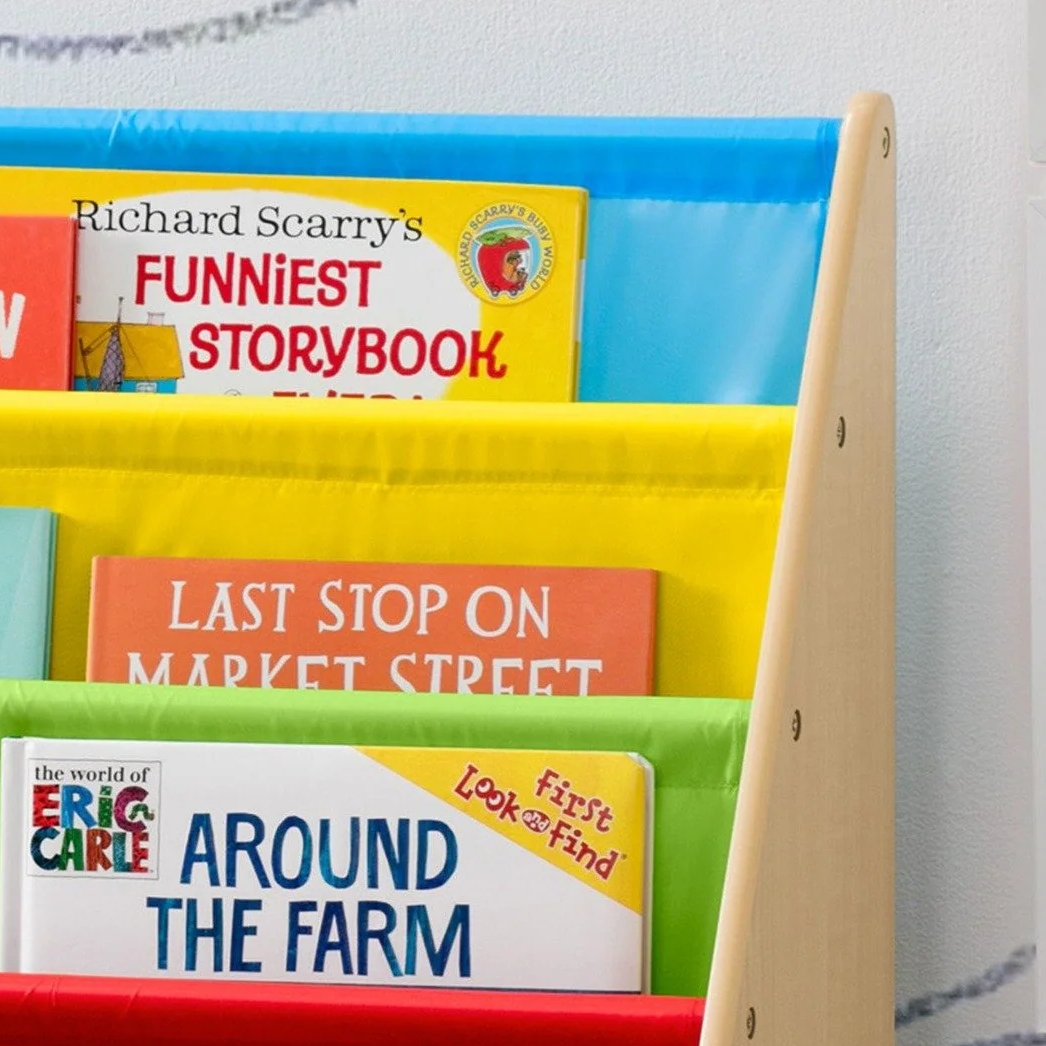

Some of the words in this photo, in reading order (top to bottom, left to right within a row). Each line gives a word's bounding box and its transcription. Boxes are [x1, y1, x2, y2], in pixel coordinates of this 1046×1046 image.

[72, 199, 245, 236] Richard
[256, 206, 424, 248] Scarry's
[460, 232, 478, 288] RICHARD
[470, 204, 525, 230] SCARRY'S
[530, 246, 553, 290] WORLD
[169, 580, 295, 633] LAST
[318, 579, 447, 635] STOP
[466, 585, 550, 638] ON
[34, 765, 65, 781] the
[70, 766, 125, 782] world
[130, 766, 151, 782] of
[535, 768, 613, 833] First
[30, 826, 150, 873] CARLE
[180, 813, 458, 890] AROUND
[454, 764, 521, 823] Look
[523, 811, 550, 833] and
[548, 819, 620, 880] Find
[147, 897, 262, 972] THE
[286, 901, 471, 977] FARM
